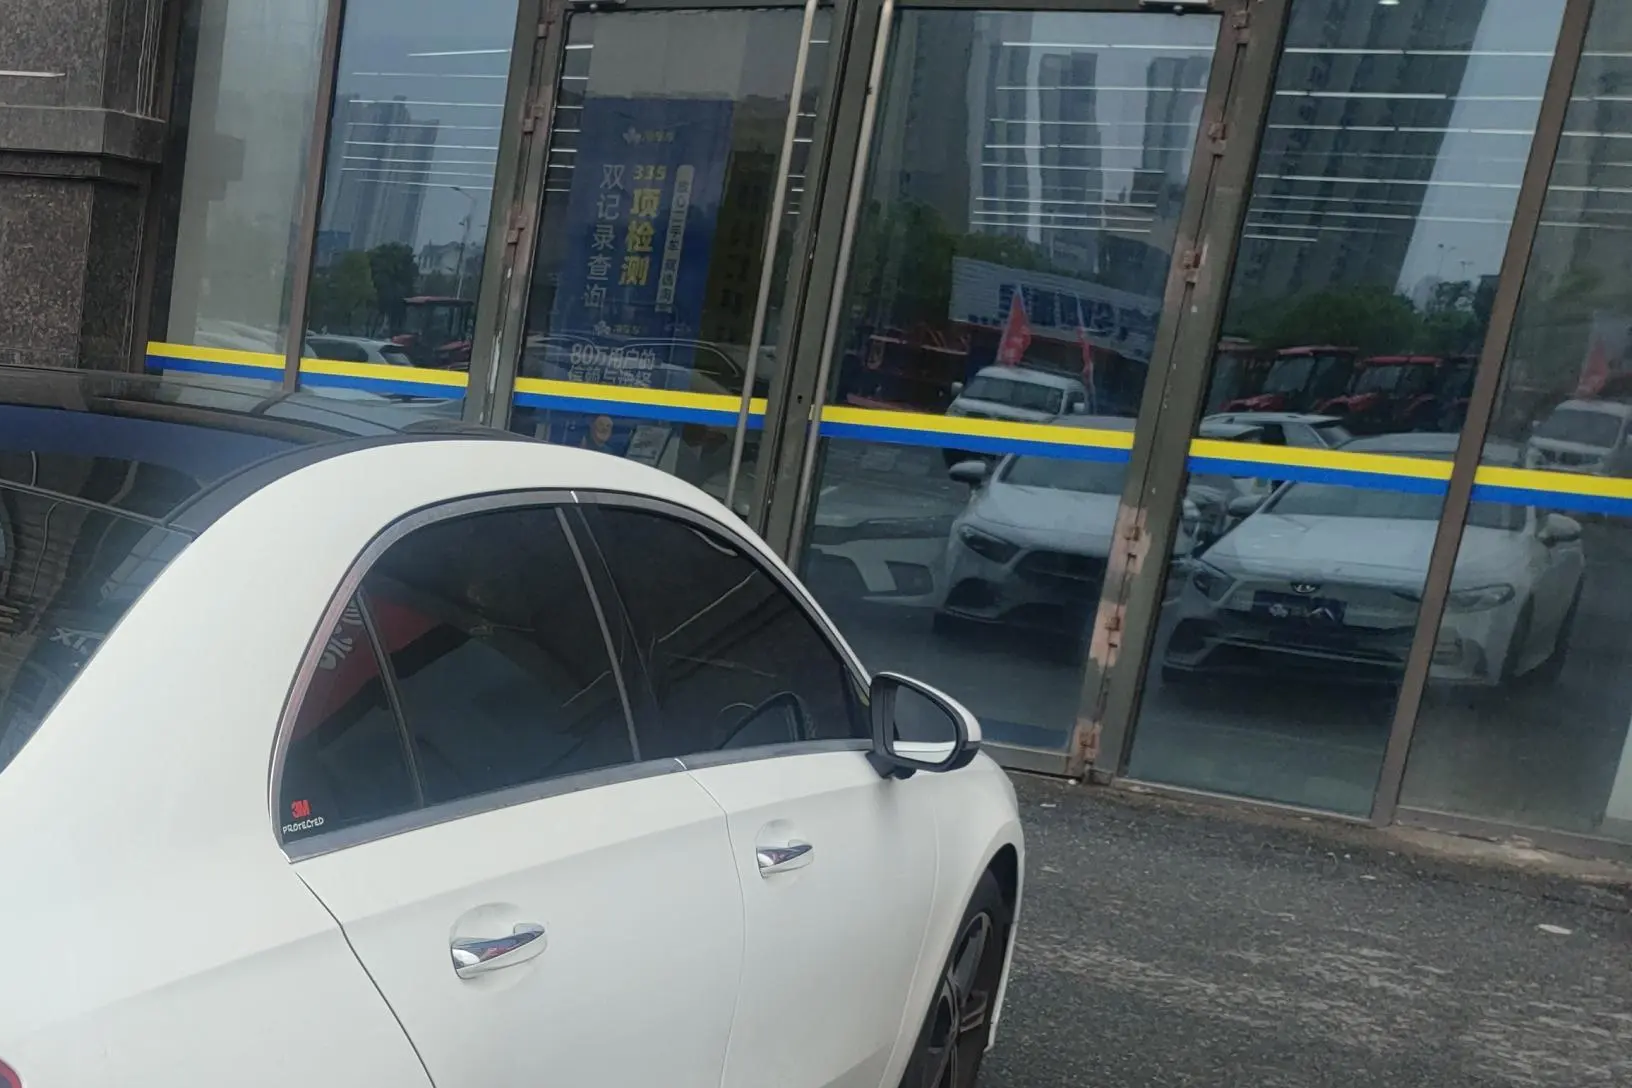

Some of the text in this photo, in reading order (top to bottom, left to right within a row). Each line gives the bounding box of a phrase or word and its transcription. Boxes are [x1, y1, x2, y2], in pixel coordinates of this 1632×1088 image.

[583, 163, 625, 308] 双记录查询
[290, 799, 312, 819] 3M
[282, 816, 325, 835] PROTECTED
